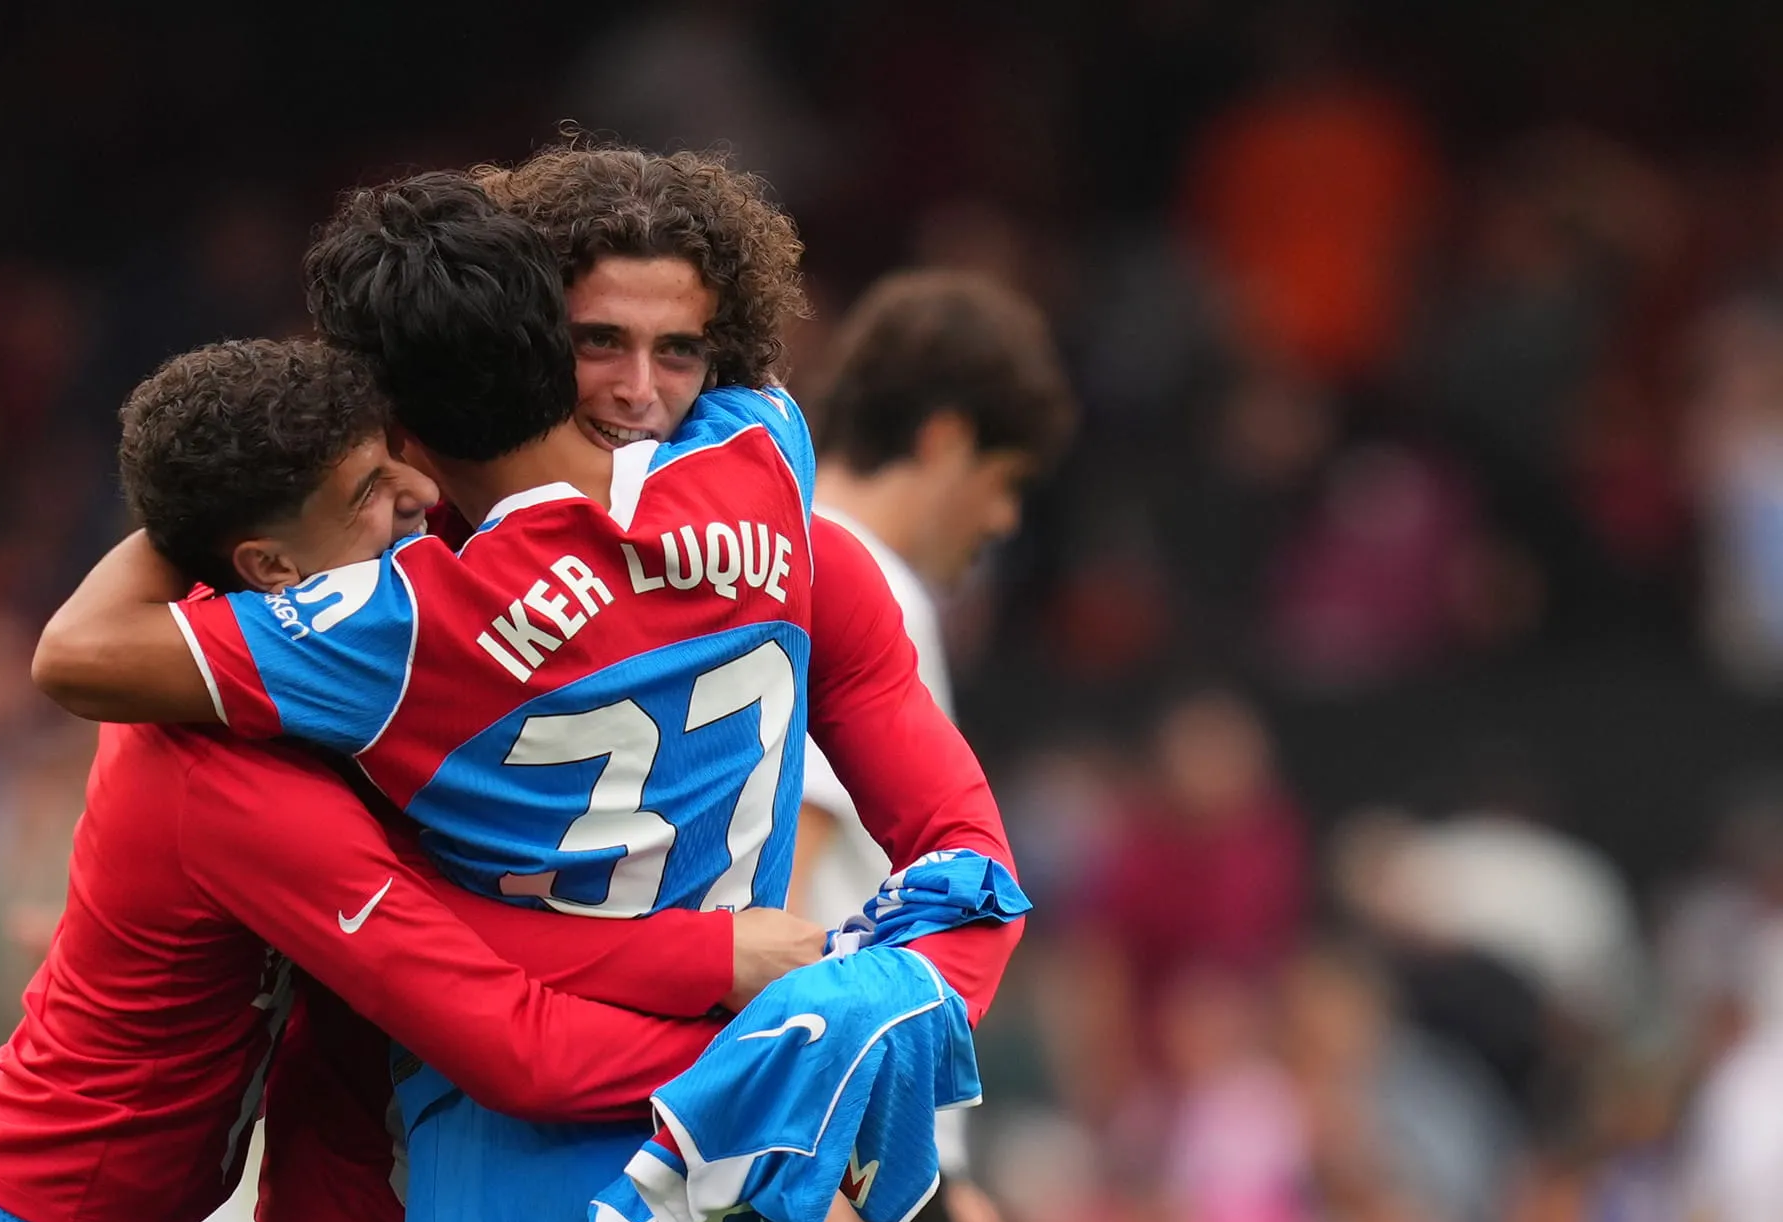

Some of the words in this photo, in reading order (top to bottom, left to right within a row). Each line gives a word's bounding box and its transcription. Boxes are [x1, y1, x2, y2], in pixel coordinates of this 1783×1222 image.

[476, 554, 614, 684] IKER
[620, 520, 793, 604] LUQUE
[498, 638, 797, 918] 37
